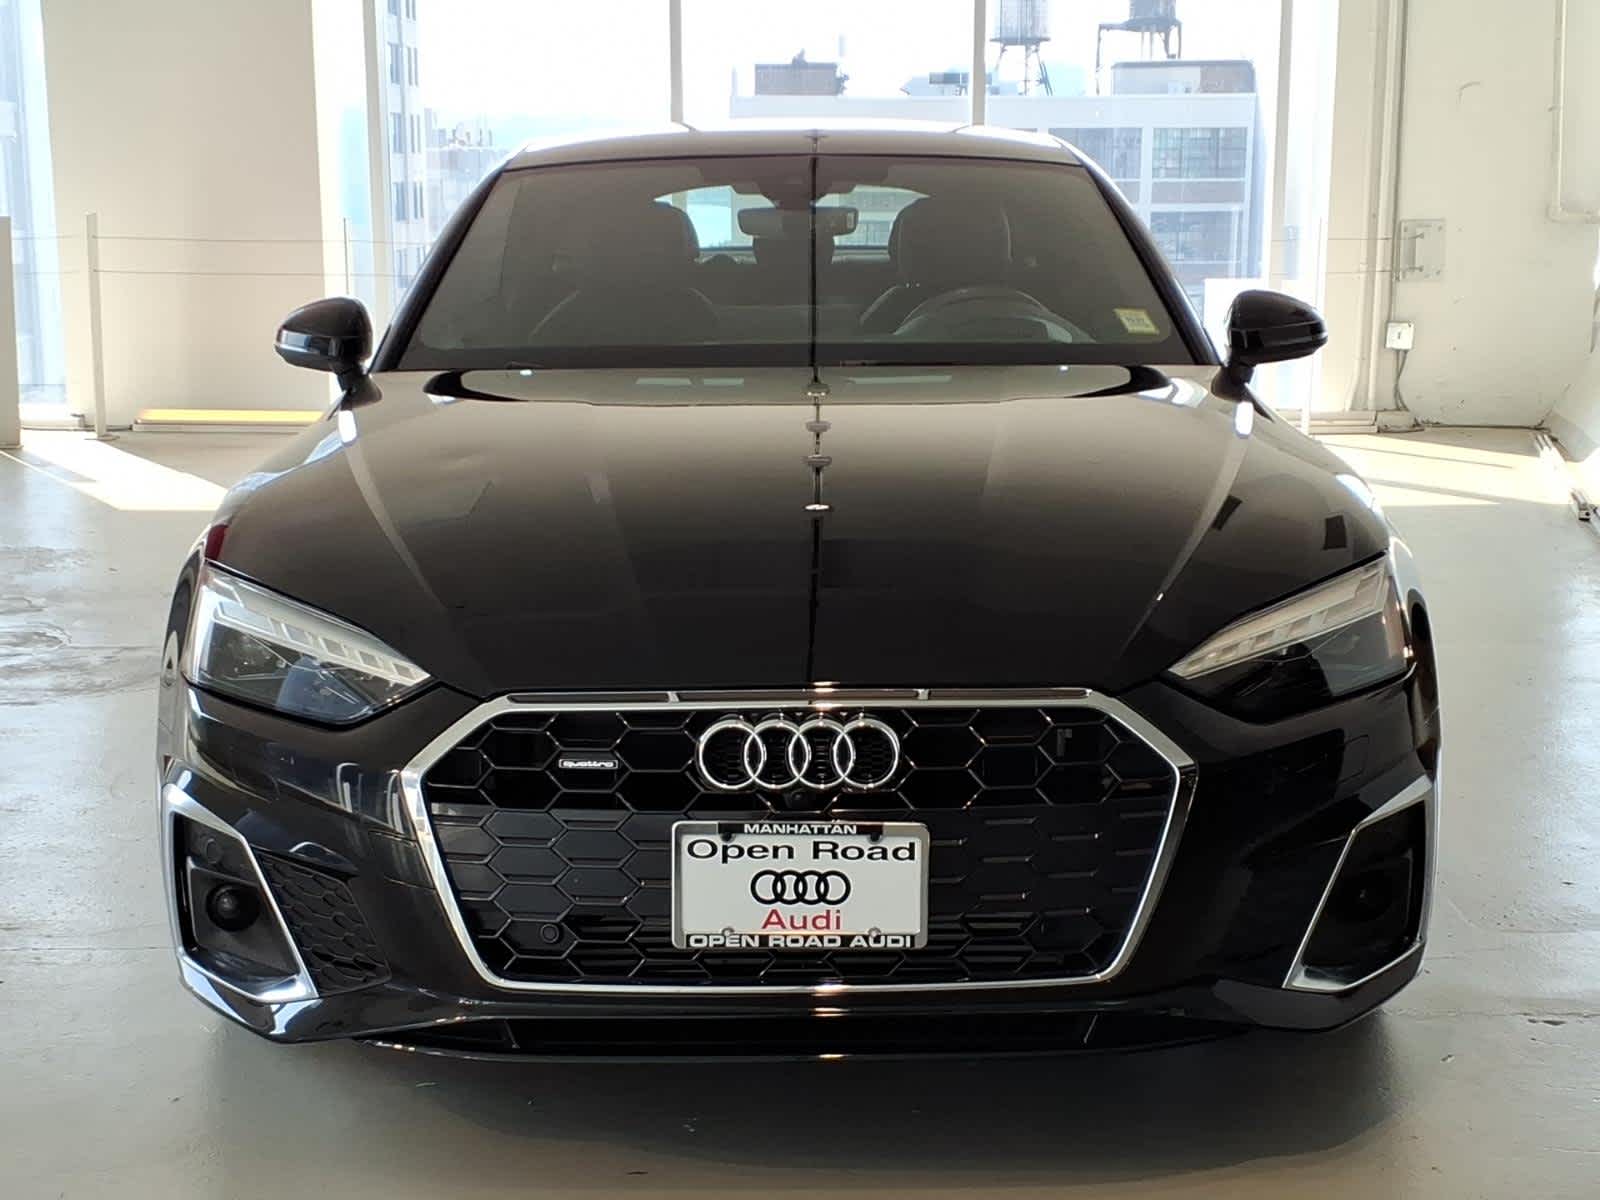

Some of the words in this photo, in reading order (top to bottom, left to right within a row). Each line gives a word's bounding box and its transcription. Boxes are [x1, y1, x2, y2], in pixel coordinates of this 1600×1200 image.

[743, 823, 857, 835] MANHATTAN
[687, 839, 794, 864] Open
[812, 840, 916, 861] Road
[761, 909, 841, 930] Audi
[689, 935, 759, 948] OPEN
[768, 935, 840, 948] ROAD
[849, 935, 911, 948] AUDI
